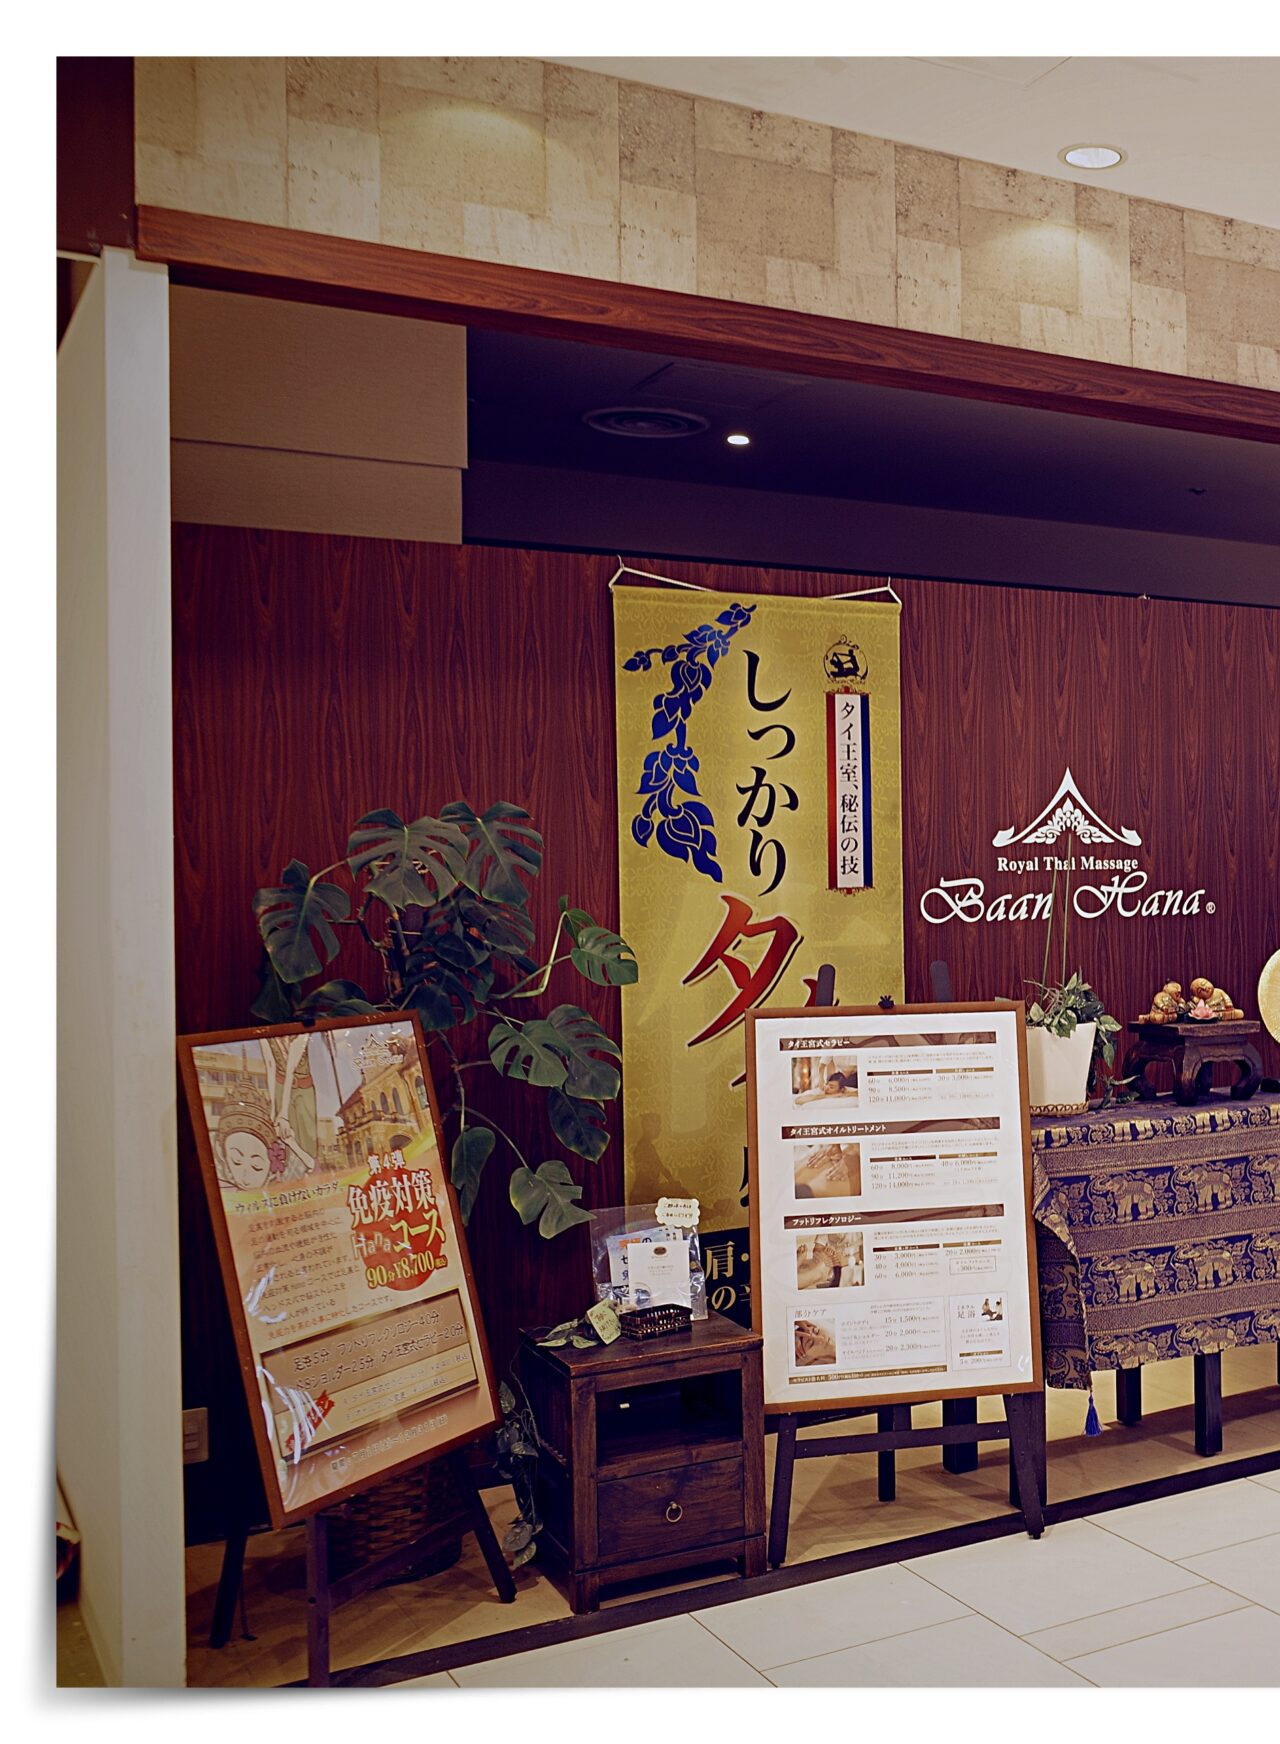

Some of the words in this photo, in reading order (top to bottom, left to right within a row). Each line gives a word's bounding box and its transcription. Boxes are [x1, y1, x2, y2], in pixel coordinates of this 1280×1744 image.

[736, 649, 799, 897] しっかり
[839, 701, 860, 876] タイ王室、秘伝の技
[997, 857, 1039, 874] Royal
[1043, 856, 1077, 871] Thai
[1081, 856, 1139, 873] Massage
[920, 877, 1055, 924] Baan
[1073, 871, 1205, 919] Hana
[367, 1148, 405, 1174] 第4弾
[343, 1166, 437, 1229] 免疫対策
[388, 1207, 446, 1256] コース
